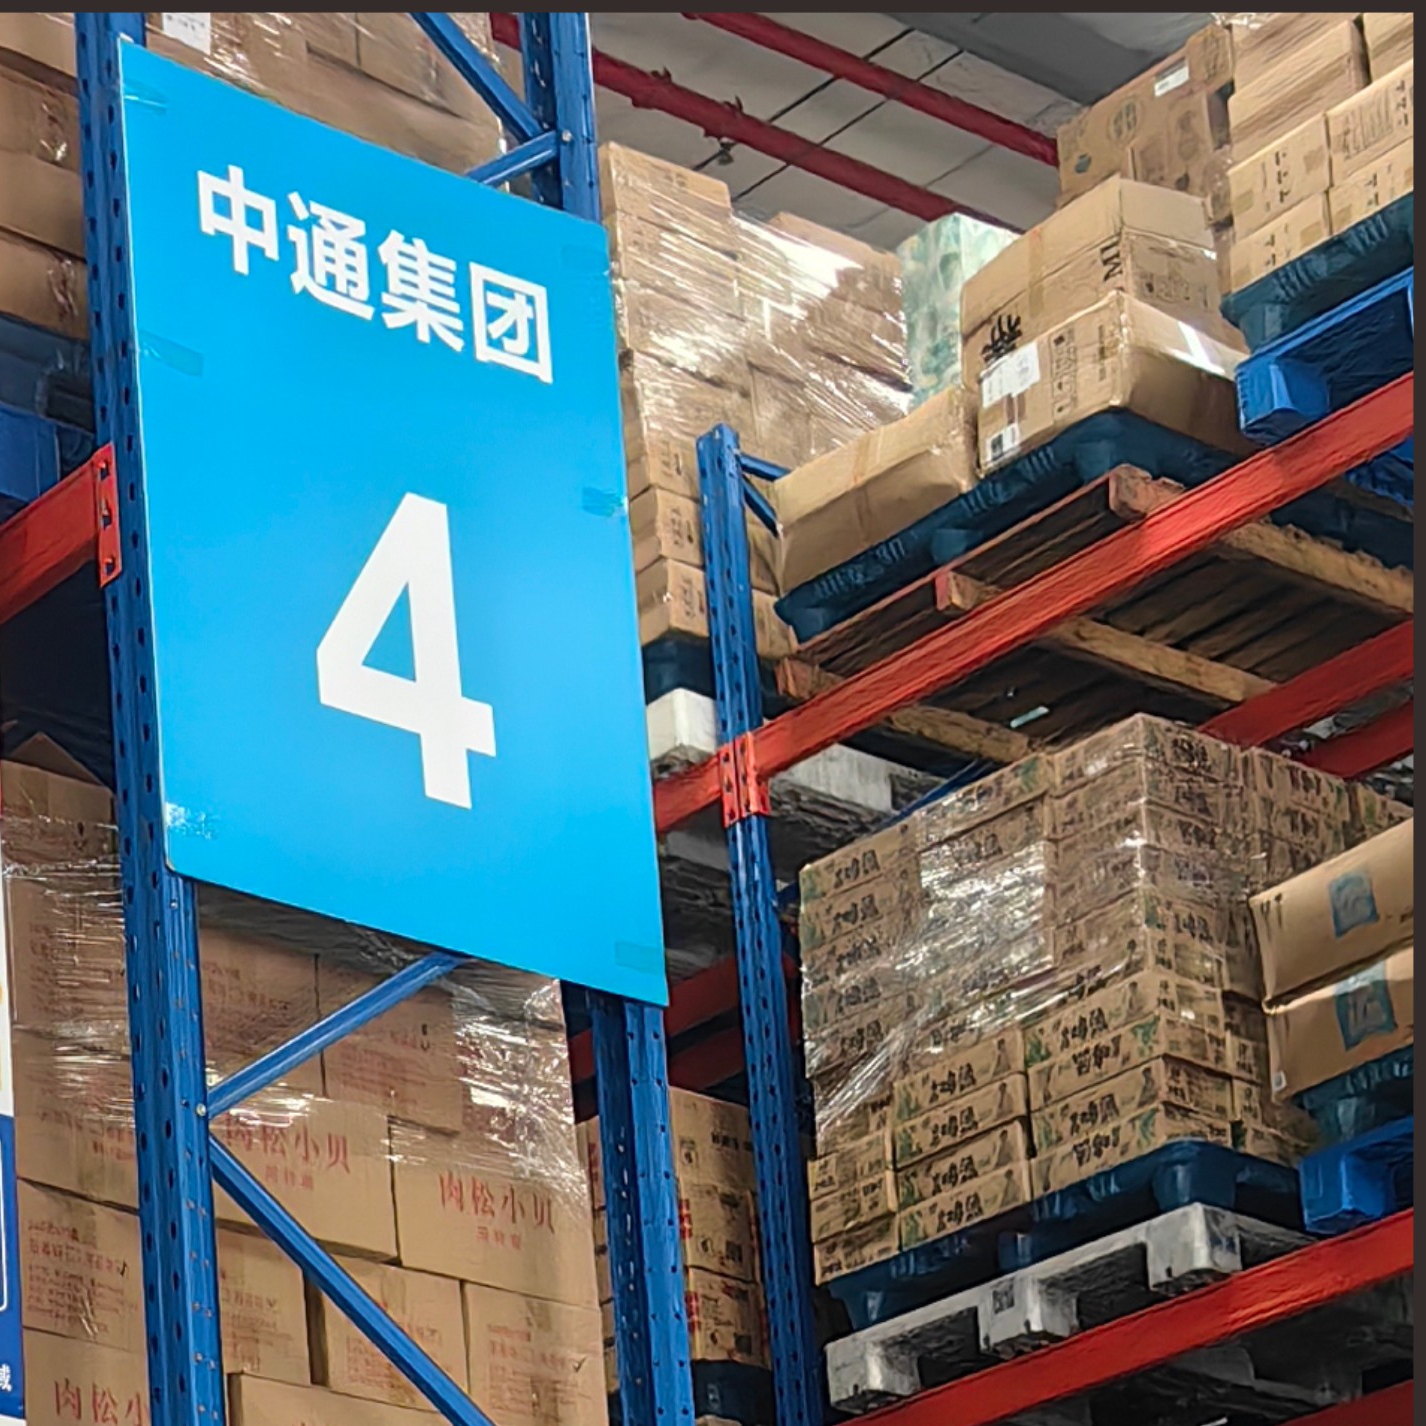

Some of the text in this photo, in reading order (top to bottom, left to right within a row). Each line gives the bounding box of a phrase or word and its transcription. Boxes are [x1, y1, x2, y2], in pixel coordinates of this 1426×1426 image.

[197, 164, 553, 384] 中通集团
[316, 491, 497, 811] 4
[438, 1169, 556, 1235] 肉松小贝
